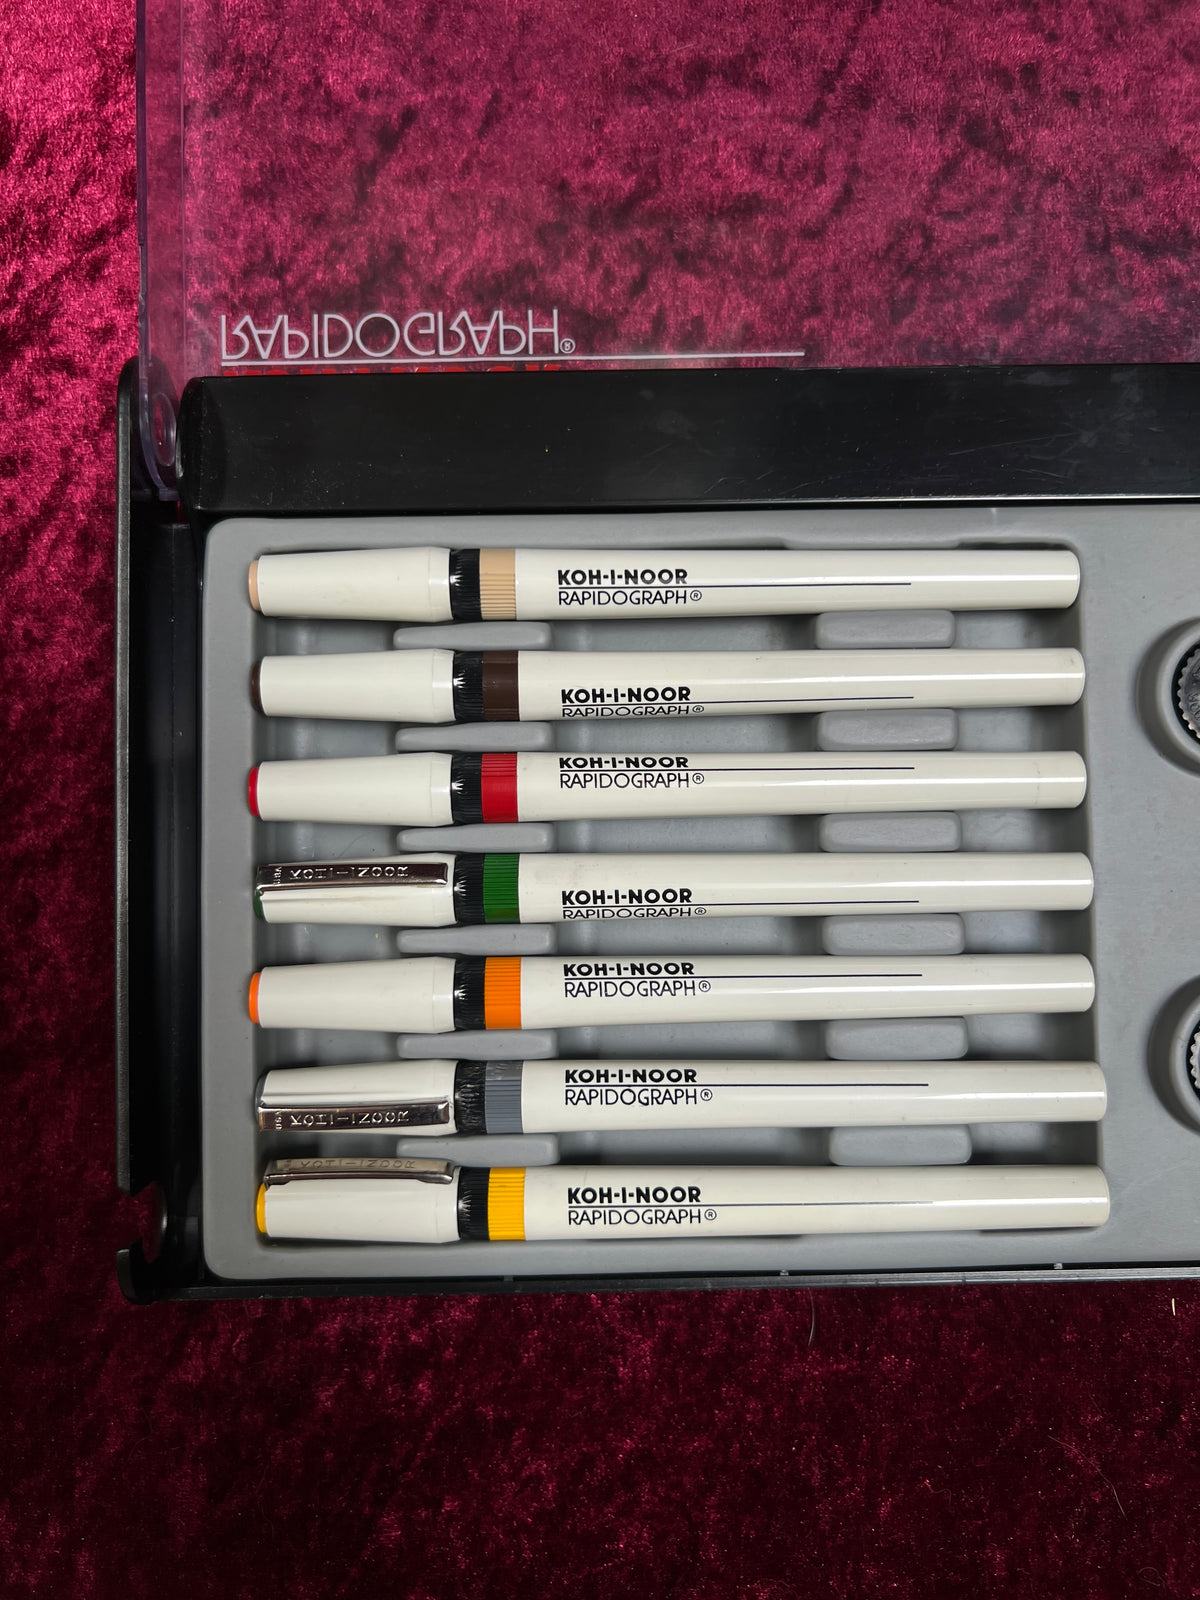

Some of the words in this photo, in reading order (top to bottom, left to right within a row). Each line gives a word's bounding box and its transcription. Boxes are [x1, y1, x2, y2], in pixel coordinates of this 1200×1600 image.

[557, 568, 688, 585] KOH-I-NOOR
[561, 686, 691, 704] KOH-I-NOOR
[559, 756, 689, 769] KOH-I-NOOR
[561, 888, 692, 905] KOH-I-NOOR
[563, 962, 695, 977] KOH-I-NOOR
[565, 1068, 697, 1084] KOH-I-NOOR
[567, 1186, 701, 1204] KOH-I-NOOR
